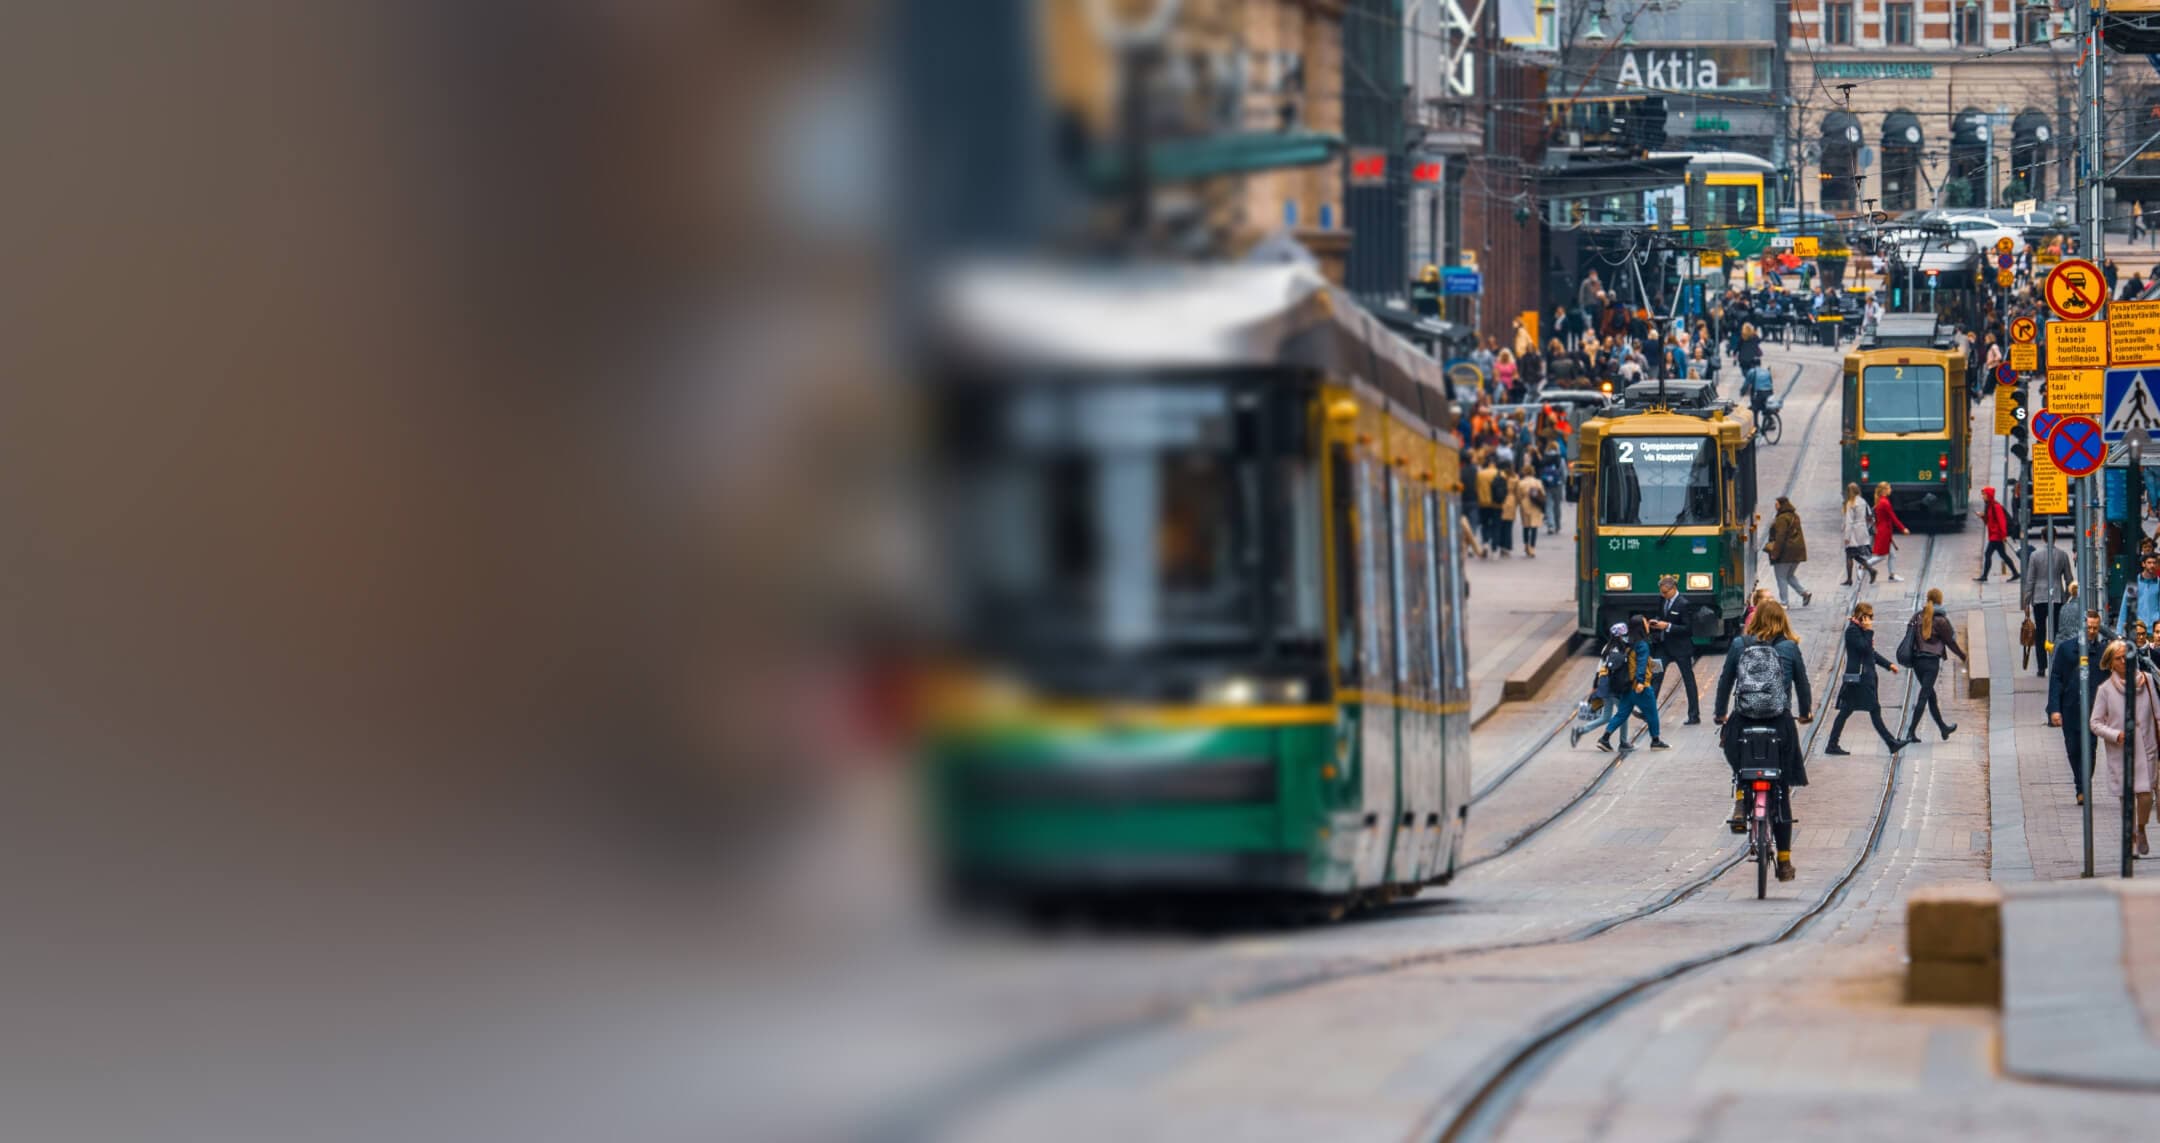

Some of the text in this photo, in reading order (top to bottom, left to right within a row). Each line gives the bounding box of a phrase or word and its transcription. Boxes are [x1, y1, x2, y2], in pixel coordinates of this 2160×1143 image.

[1615, 51, 1718, 90] Aktia
[2054, 325, 2086, 334] Ei koske
[1894, 367, 1903, 379] 2
[2015, 407, 2026, 420] S
[1618, 441, 1634, 463] 2
[1918, 470, 1932, 480] 89
